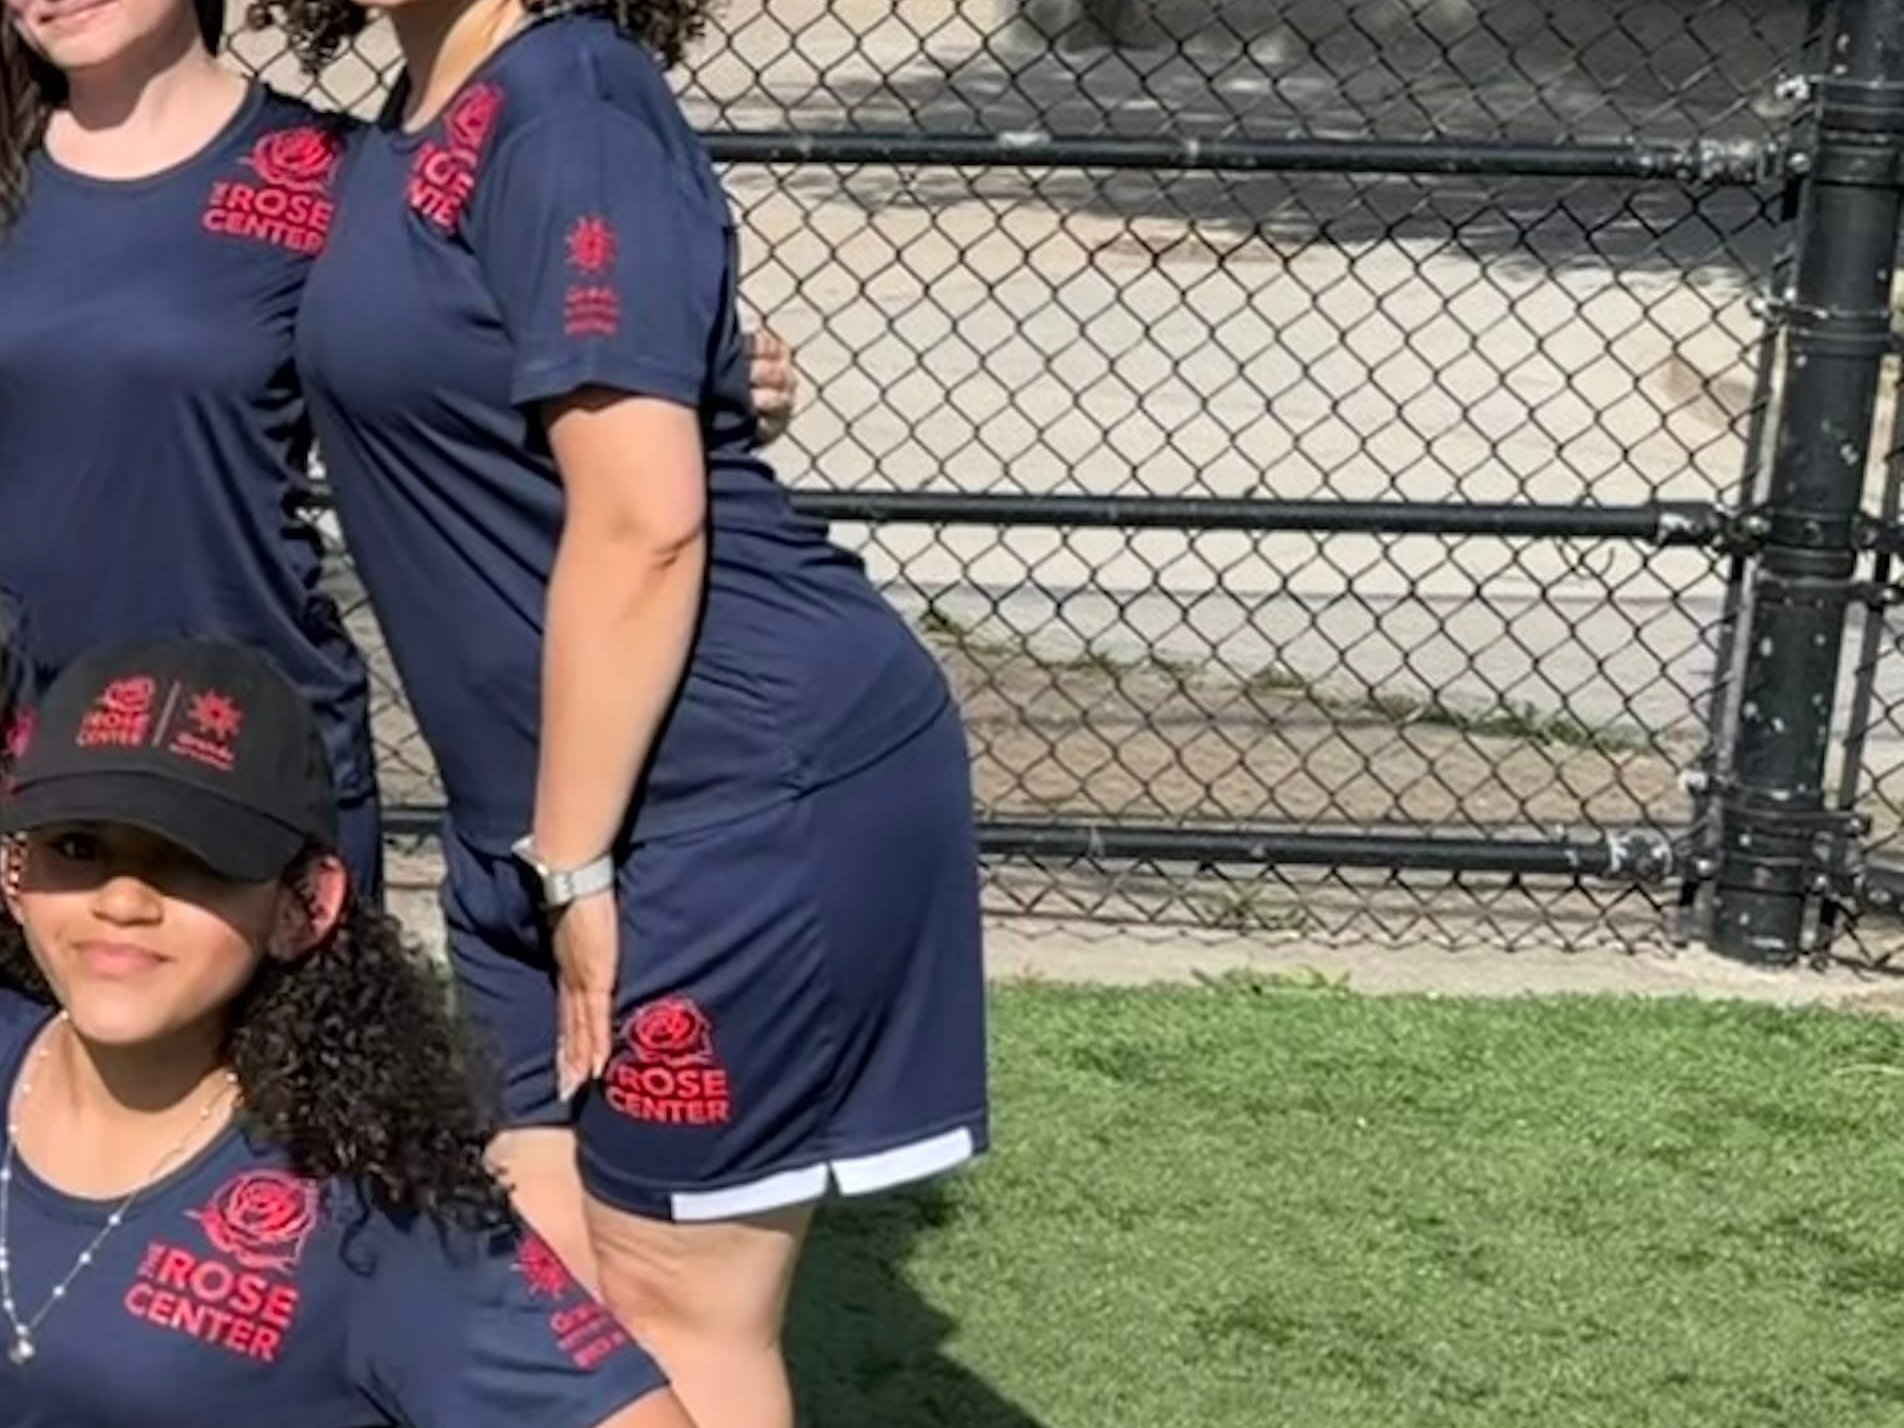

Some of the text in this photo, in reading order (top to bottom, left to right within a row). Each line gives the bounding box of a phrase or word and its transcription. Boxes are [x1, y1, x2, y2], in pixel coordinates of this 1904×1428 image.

[226, 182, 334, 232] ROSE
[605, 1085, 730, 1126] CENTER
[618, 1065, 727, 1098] ROSE
[157, 1246, 299, 1329] ROSE
[124, 1282, 279, 1363] CENTER
